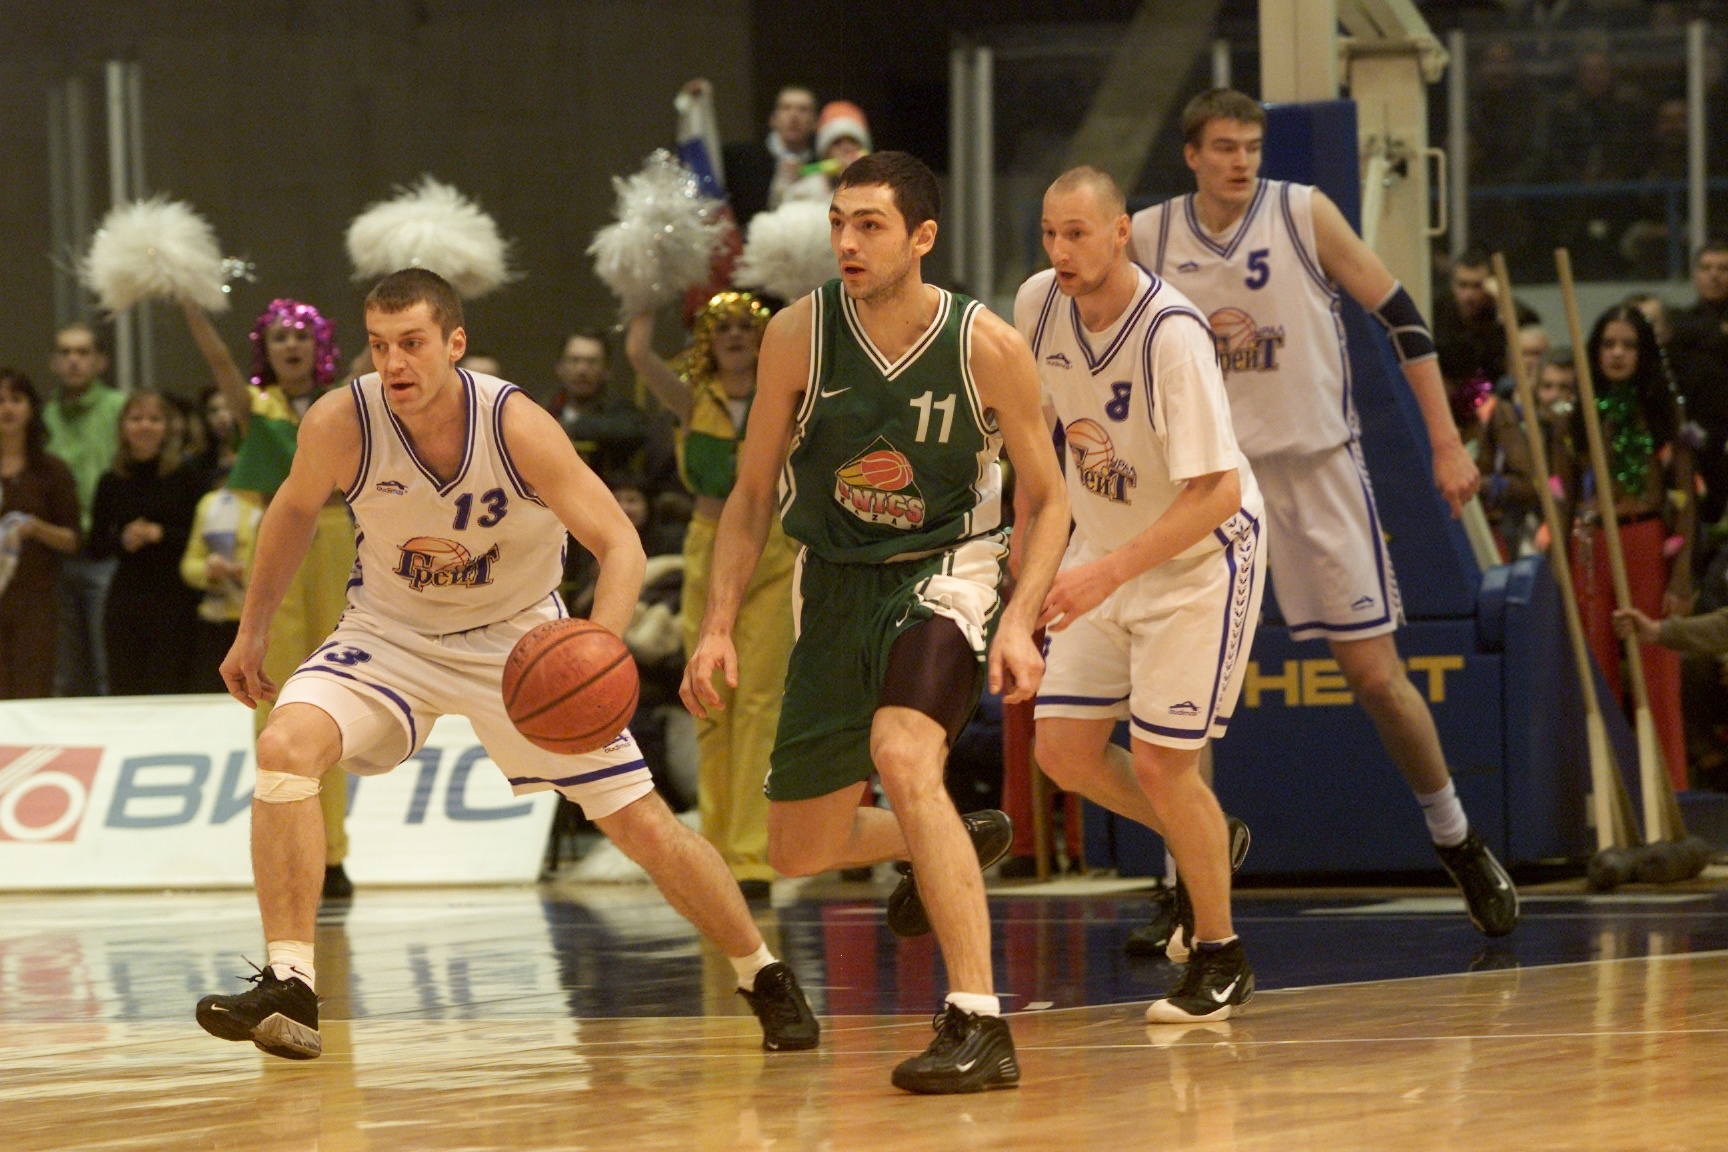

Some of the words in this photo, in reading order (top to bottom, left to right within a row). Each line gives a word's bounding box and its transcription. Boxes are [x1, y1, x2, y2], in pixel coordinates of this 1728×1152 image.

[1244, 248, 1270, 291] 5
[910, 390, 957, 444] 11
[1105, 381, 1133, 422] 8
[452, 487, 509, 531] 13
